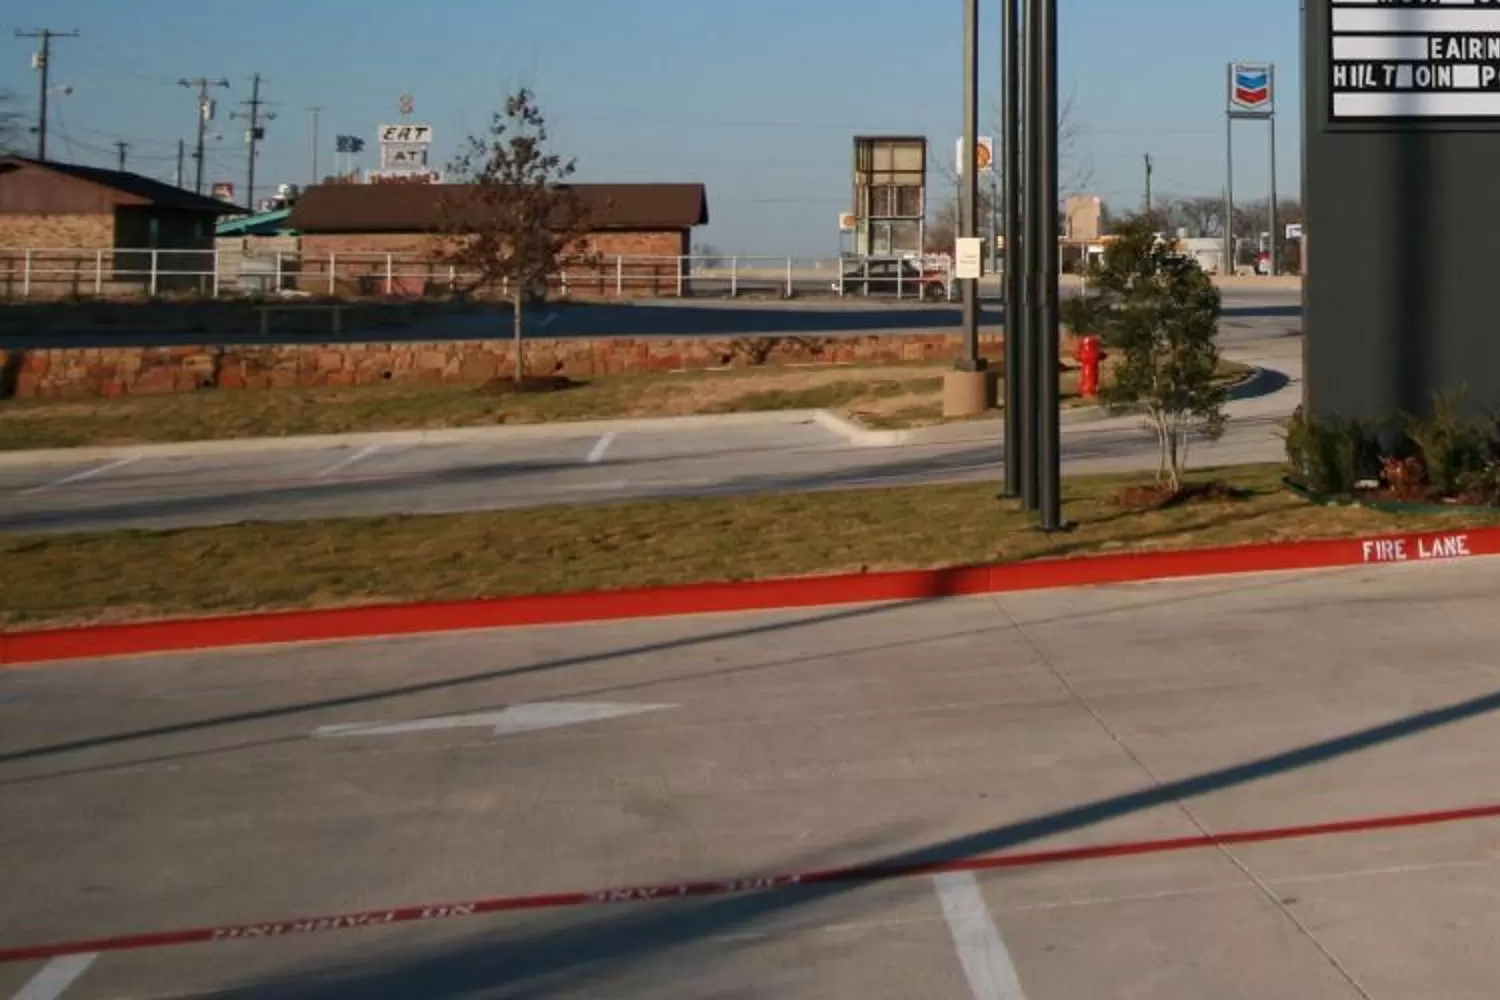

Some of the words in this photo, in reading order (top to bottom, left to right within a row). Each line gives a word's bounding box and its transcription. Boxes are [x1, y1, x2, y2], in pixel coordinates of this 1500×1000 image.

[1431, 37, 1500, 59] EARN
[383, 127, 429, 140] EAT
[394, 151, 419, 161] AT
[1362, 539, 1408, 561] FIRE
[1417, 535, 1470, 558] LANE
